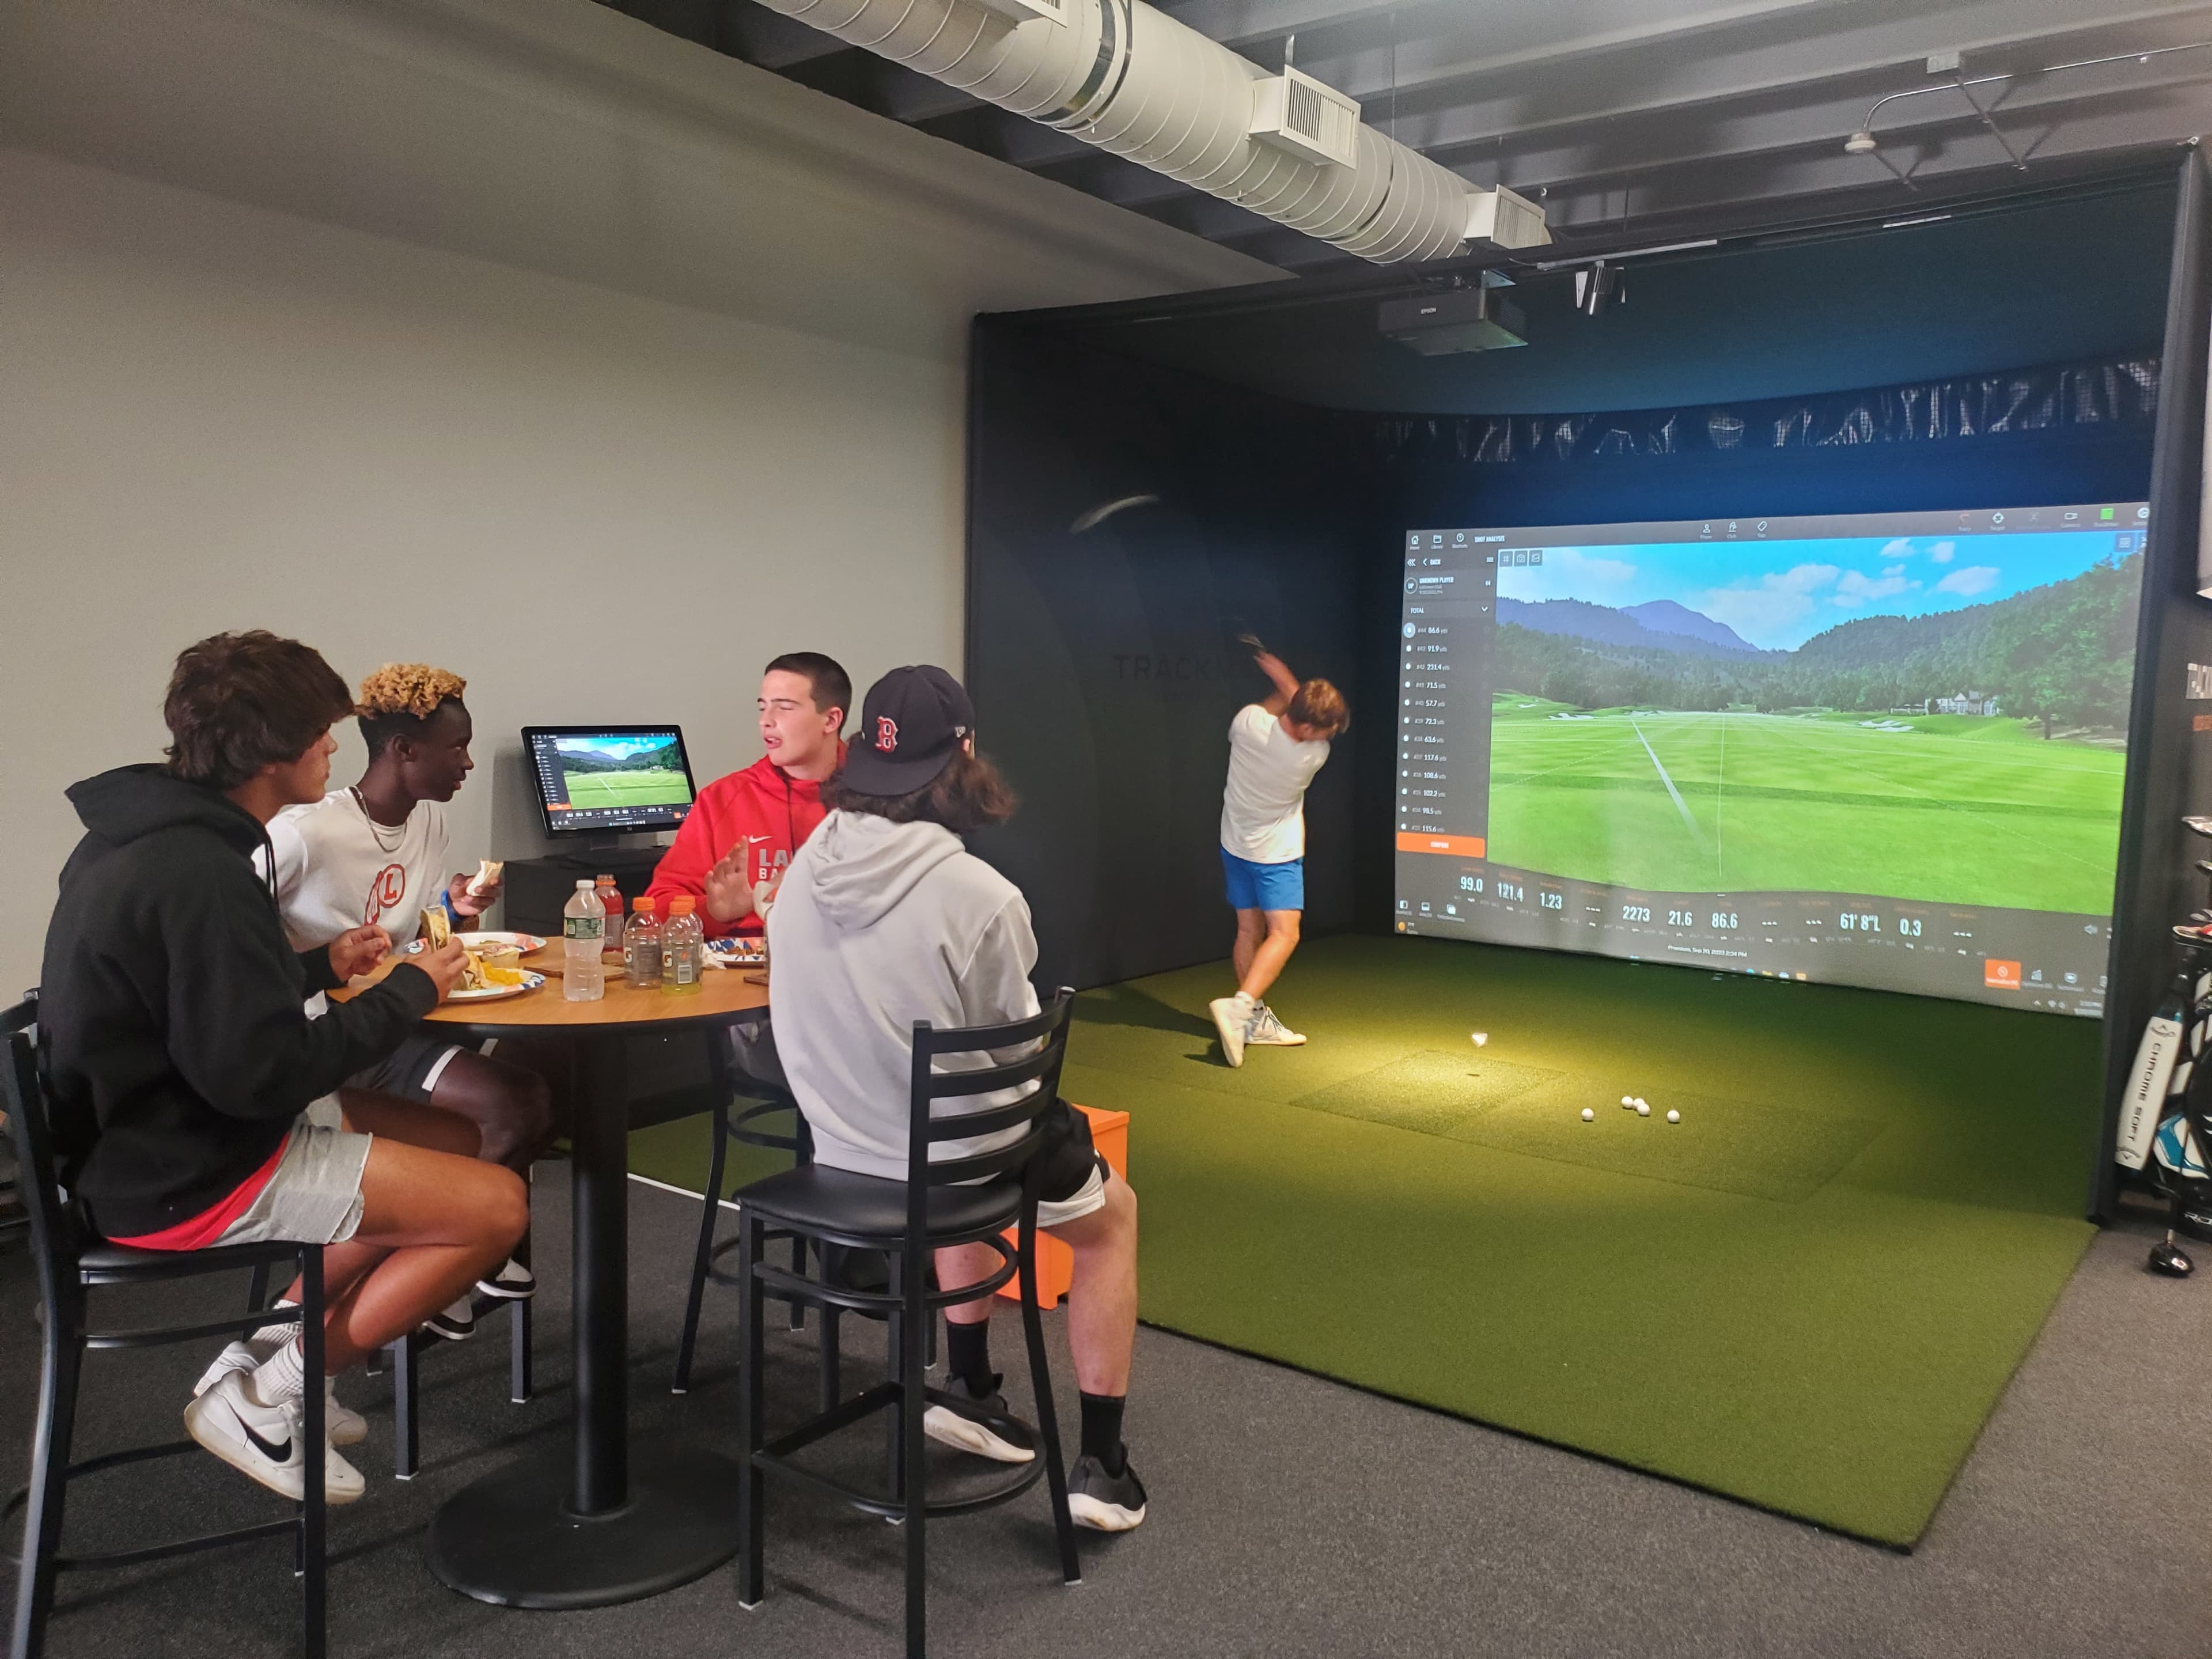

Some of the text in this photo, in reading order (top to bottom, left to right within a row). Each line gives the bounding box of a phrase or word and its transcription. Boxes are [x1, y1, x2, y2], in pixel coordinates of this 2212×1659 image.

[875, 715, 898, 753] B
[759, 849, 793, 866] LA
[384, 873, 397, 900] L
[1460, 876, 1483, 893] 99.0
[1497, 882, 1524, 903] 121.4
[1540, 892, 1562, 910] 1.23
[1623, 905, 1650, 922] 2273
[1668, 910, 1692, 926] 21.6
[1711, 912, 1738, 929] 86.6
[1899, 918, 1922, 937] 0.3
[2127, 1043, 2161, 1142] CHROME SOFT
